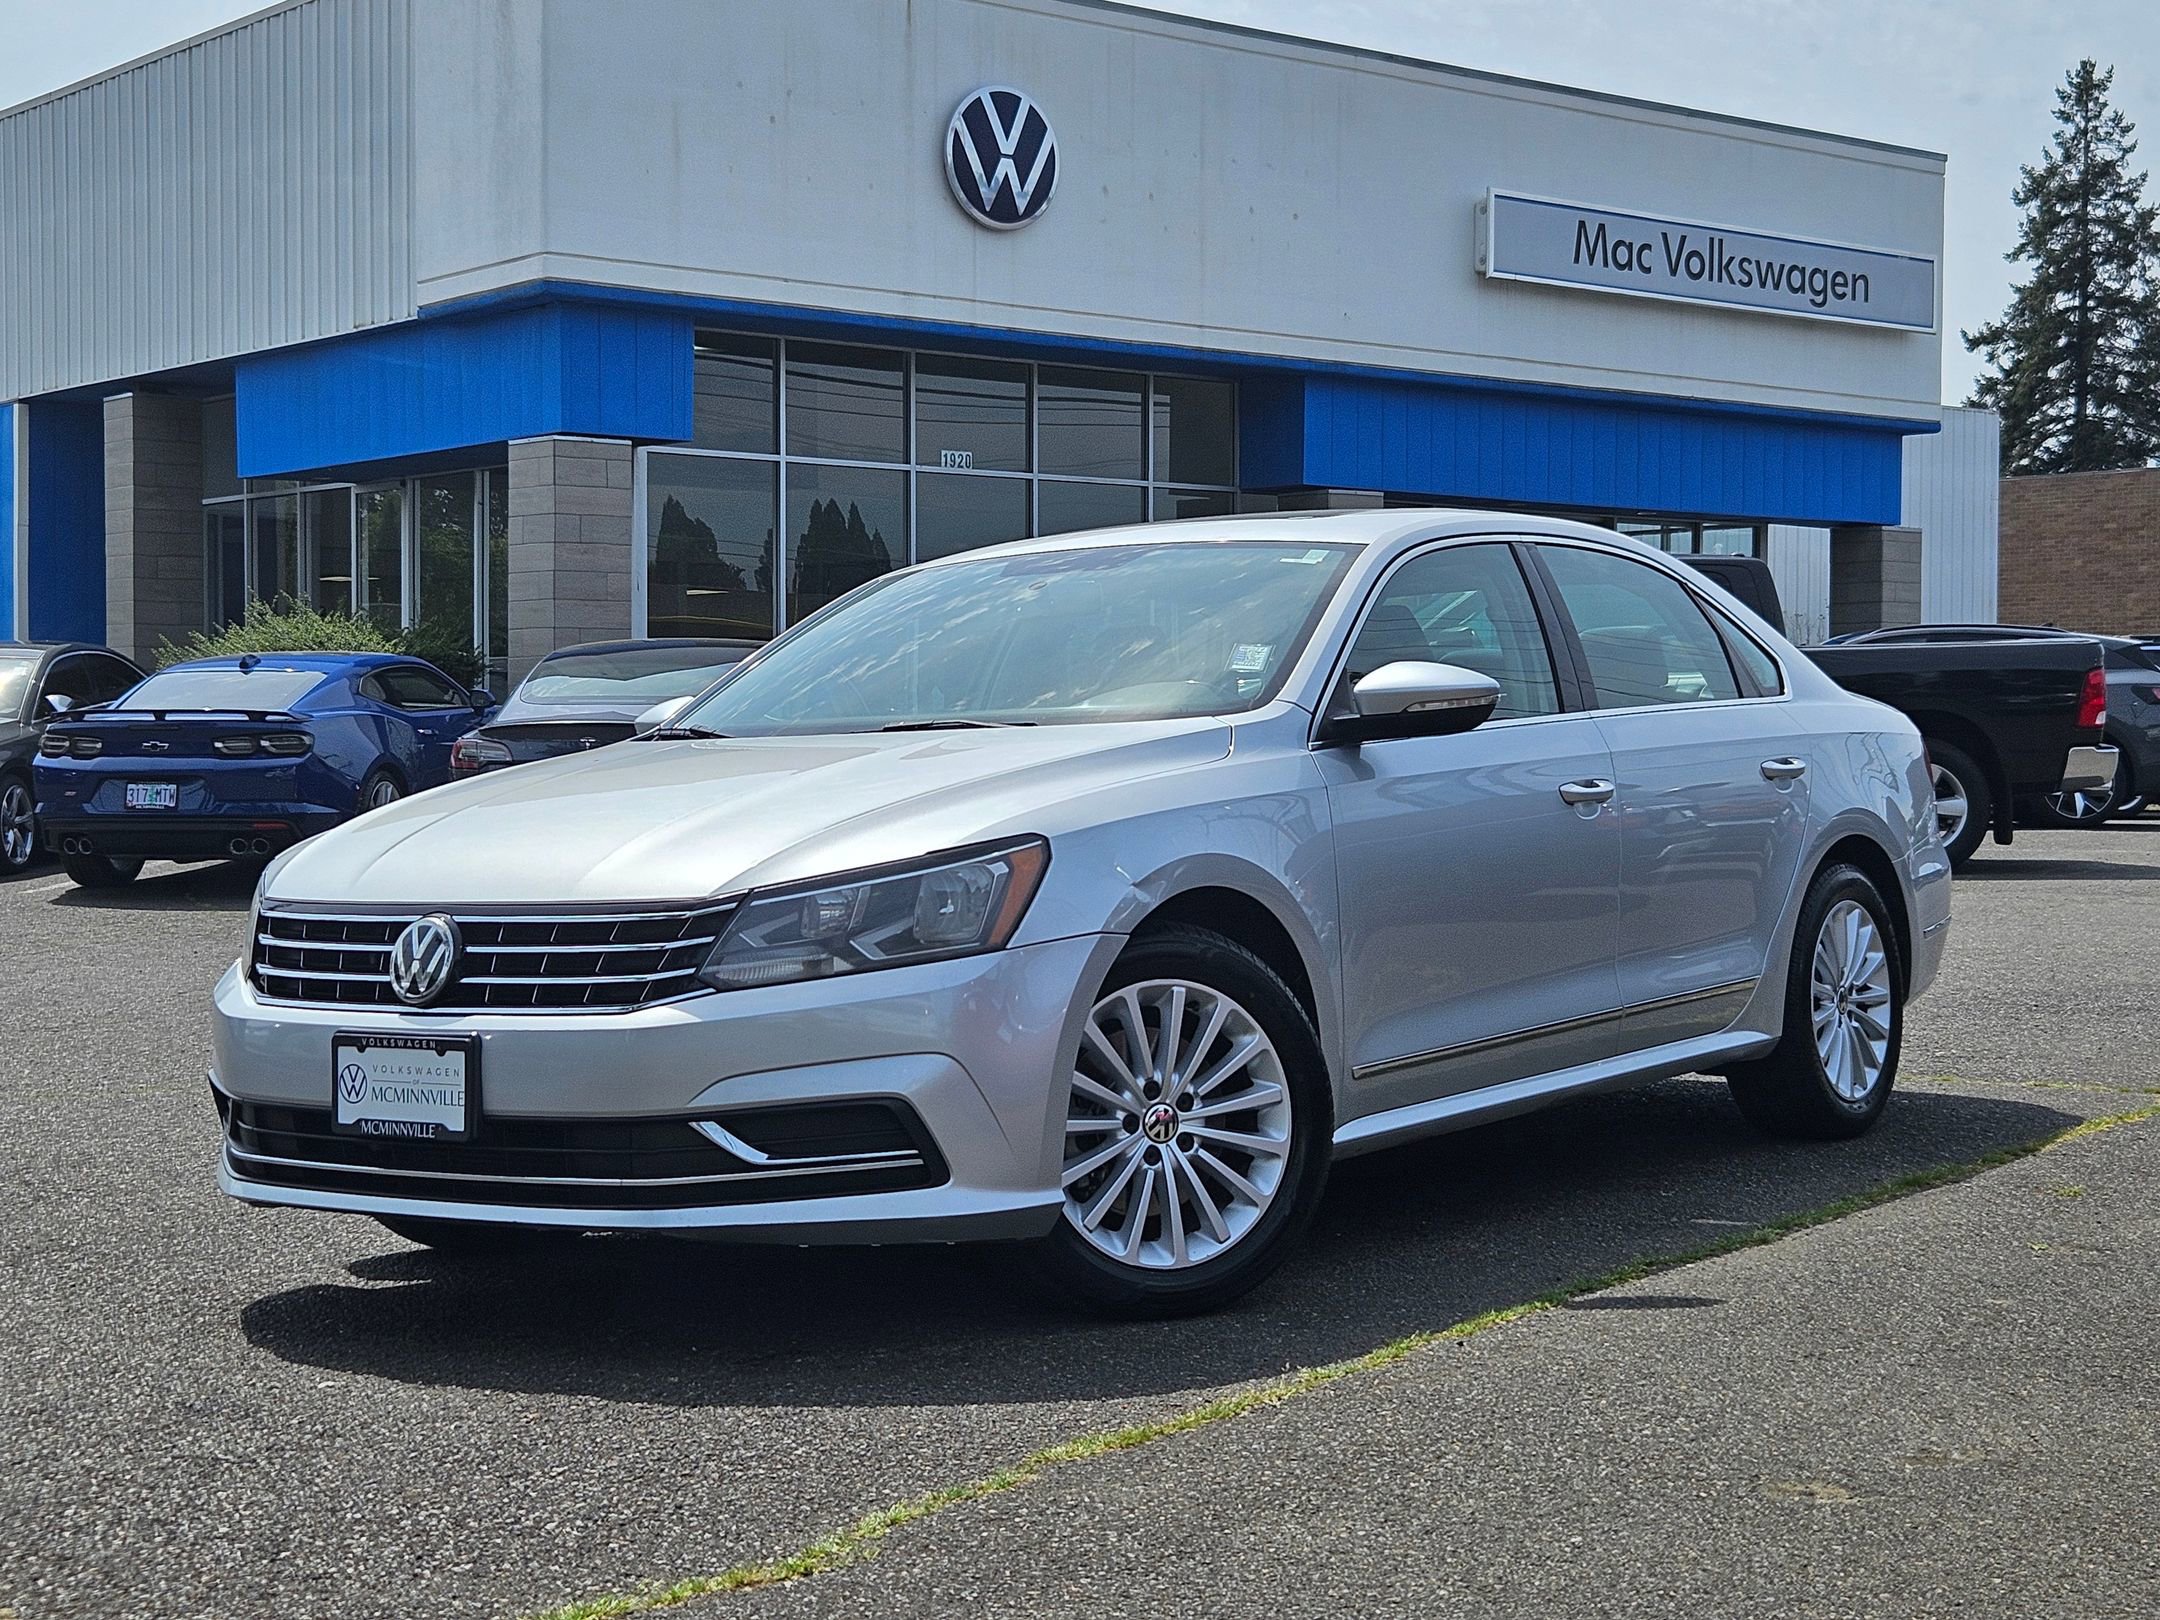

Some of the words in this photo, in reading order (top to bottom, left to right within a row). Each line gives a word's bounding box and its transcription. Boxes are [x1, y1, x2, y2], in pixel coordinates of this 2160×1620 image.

[946, 87, 1059, 229] VW
[1573, 219, 1652, 275] Mac
[1660, 231, 1869, 308] Volkswagen
[943, 452, 971, 469] 1920
[128, 787, 148, 803] 317
[361, 1038, 436, 1048] VOLKSWAGEN
[372, 1065, 460, 1077] VOLKSWAGEN
[371, 1086, 464, 1107] MCMINNVILLE
[361, 1120, 435, 1138] MCMINNVILLE
